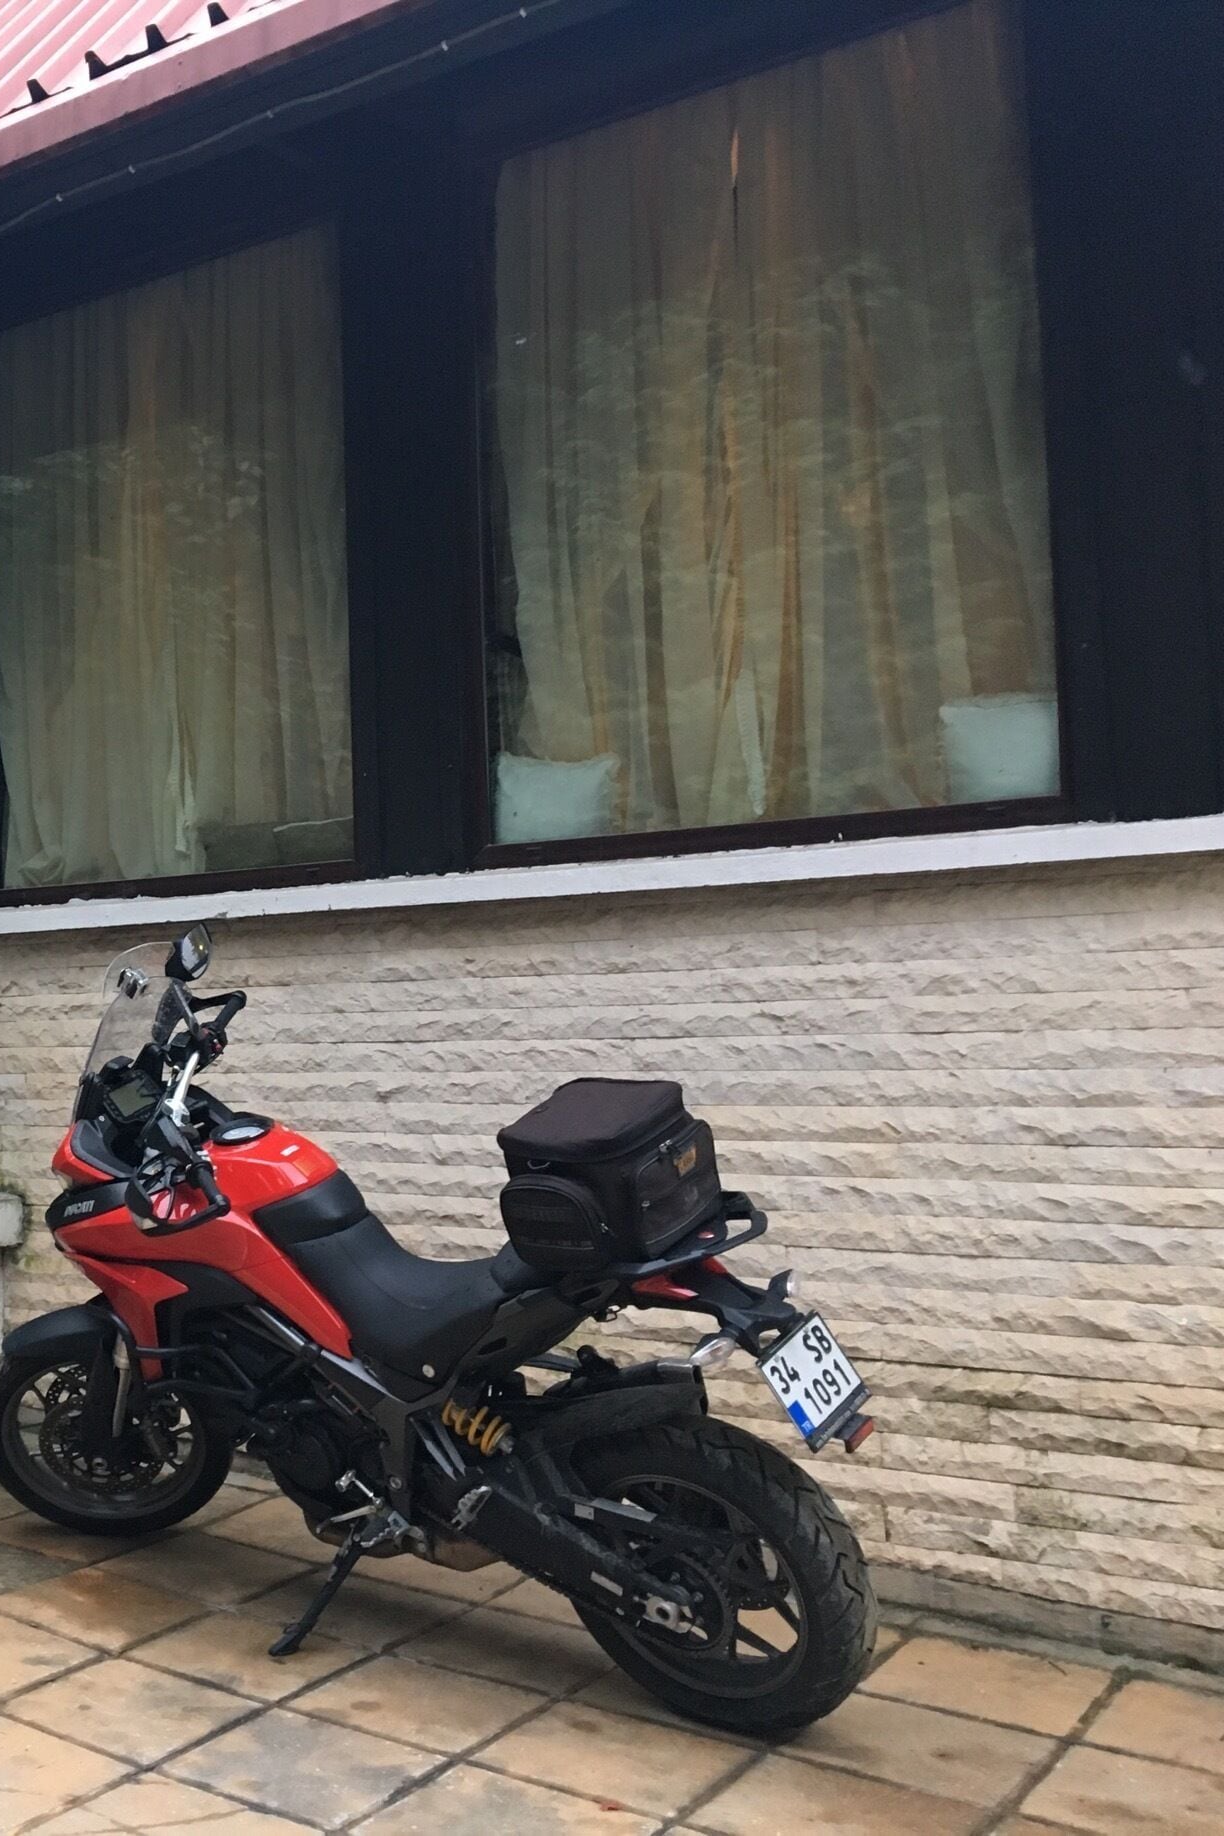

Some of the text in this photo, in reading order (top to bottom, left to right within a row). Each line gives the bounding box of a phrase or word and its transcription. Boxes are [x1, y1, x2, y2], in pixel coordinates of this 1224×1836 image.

[770, 1325, 832, 1394] 34 SB
[804, 1359, 851, 1414] 1091
